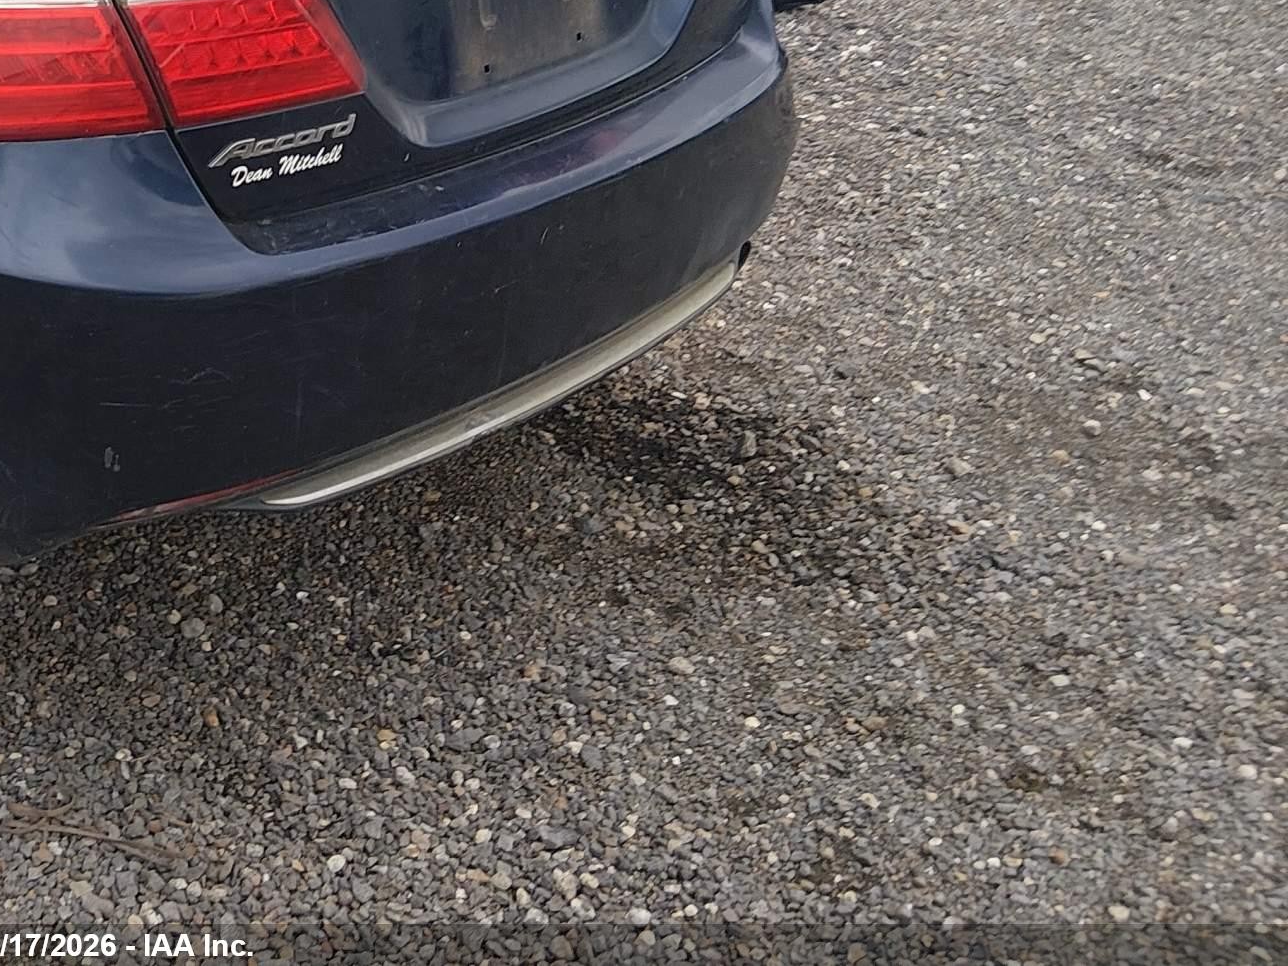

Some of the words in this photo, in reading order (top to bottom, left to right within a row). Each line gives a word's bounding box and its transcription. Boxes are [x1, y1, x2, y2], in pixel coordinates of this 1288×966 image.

[208, 113, 357, 168] Accord
[231, 165, 273, 187] Dean
[279, 144, 343, 176] Mitchell
